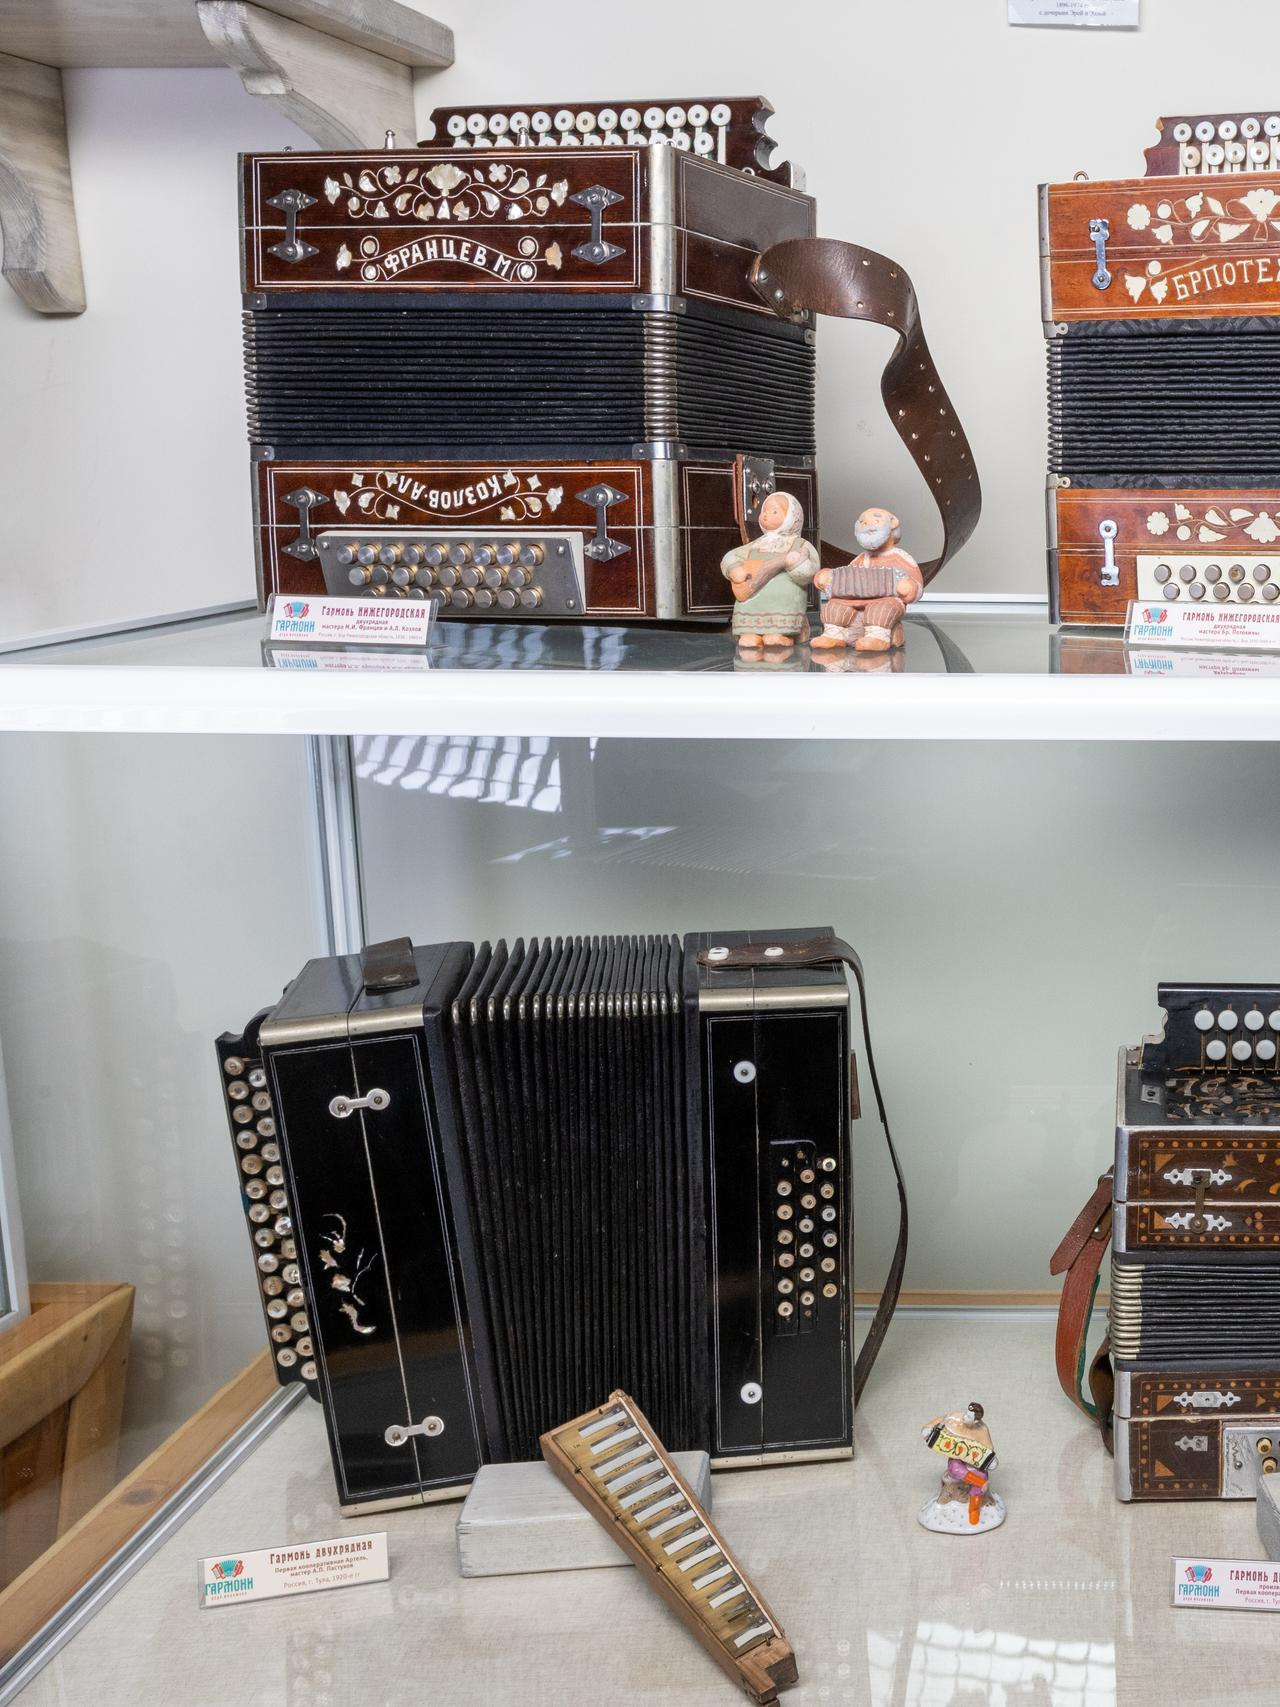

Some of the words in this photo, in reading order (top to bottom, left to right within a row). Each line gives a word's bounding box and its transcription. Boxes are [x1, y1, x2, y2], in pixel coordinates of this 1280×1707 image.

[384, 239, 487, 273] ФРАНЦЕВ
[492, 254, 512, 277] М
[321, 605, 354, 617] Гармонь
[357, 606, 426, 619] НИЖЕГОРОДСКАЯ
[1182, 611, 1215, 621] ГАРМОНЬ
[1218, 612, 1280, 624] НИЖЕГОРОДСКАЯ
[270, 1549, 311, 1565] Гармонь
[316, 1540, 373, 1558] двухрядная
[274, 1563, 297, 1574] Первая
[298, 1558, 344, 1570] кооперативная
[290, 1568, 311, 1577] мастер
[1229, 1570, 1268, 1582] ГАРМОНЬ
[1235, 1588, 1257, 1596] Первая
